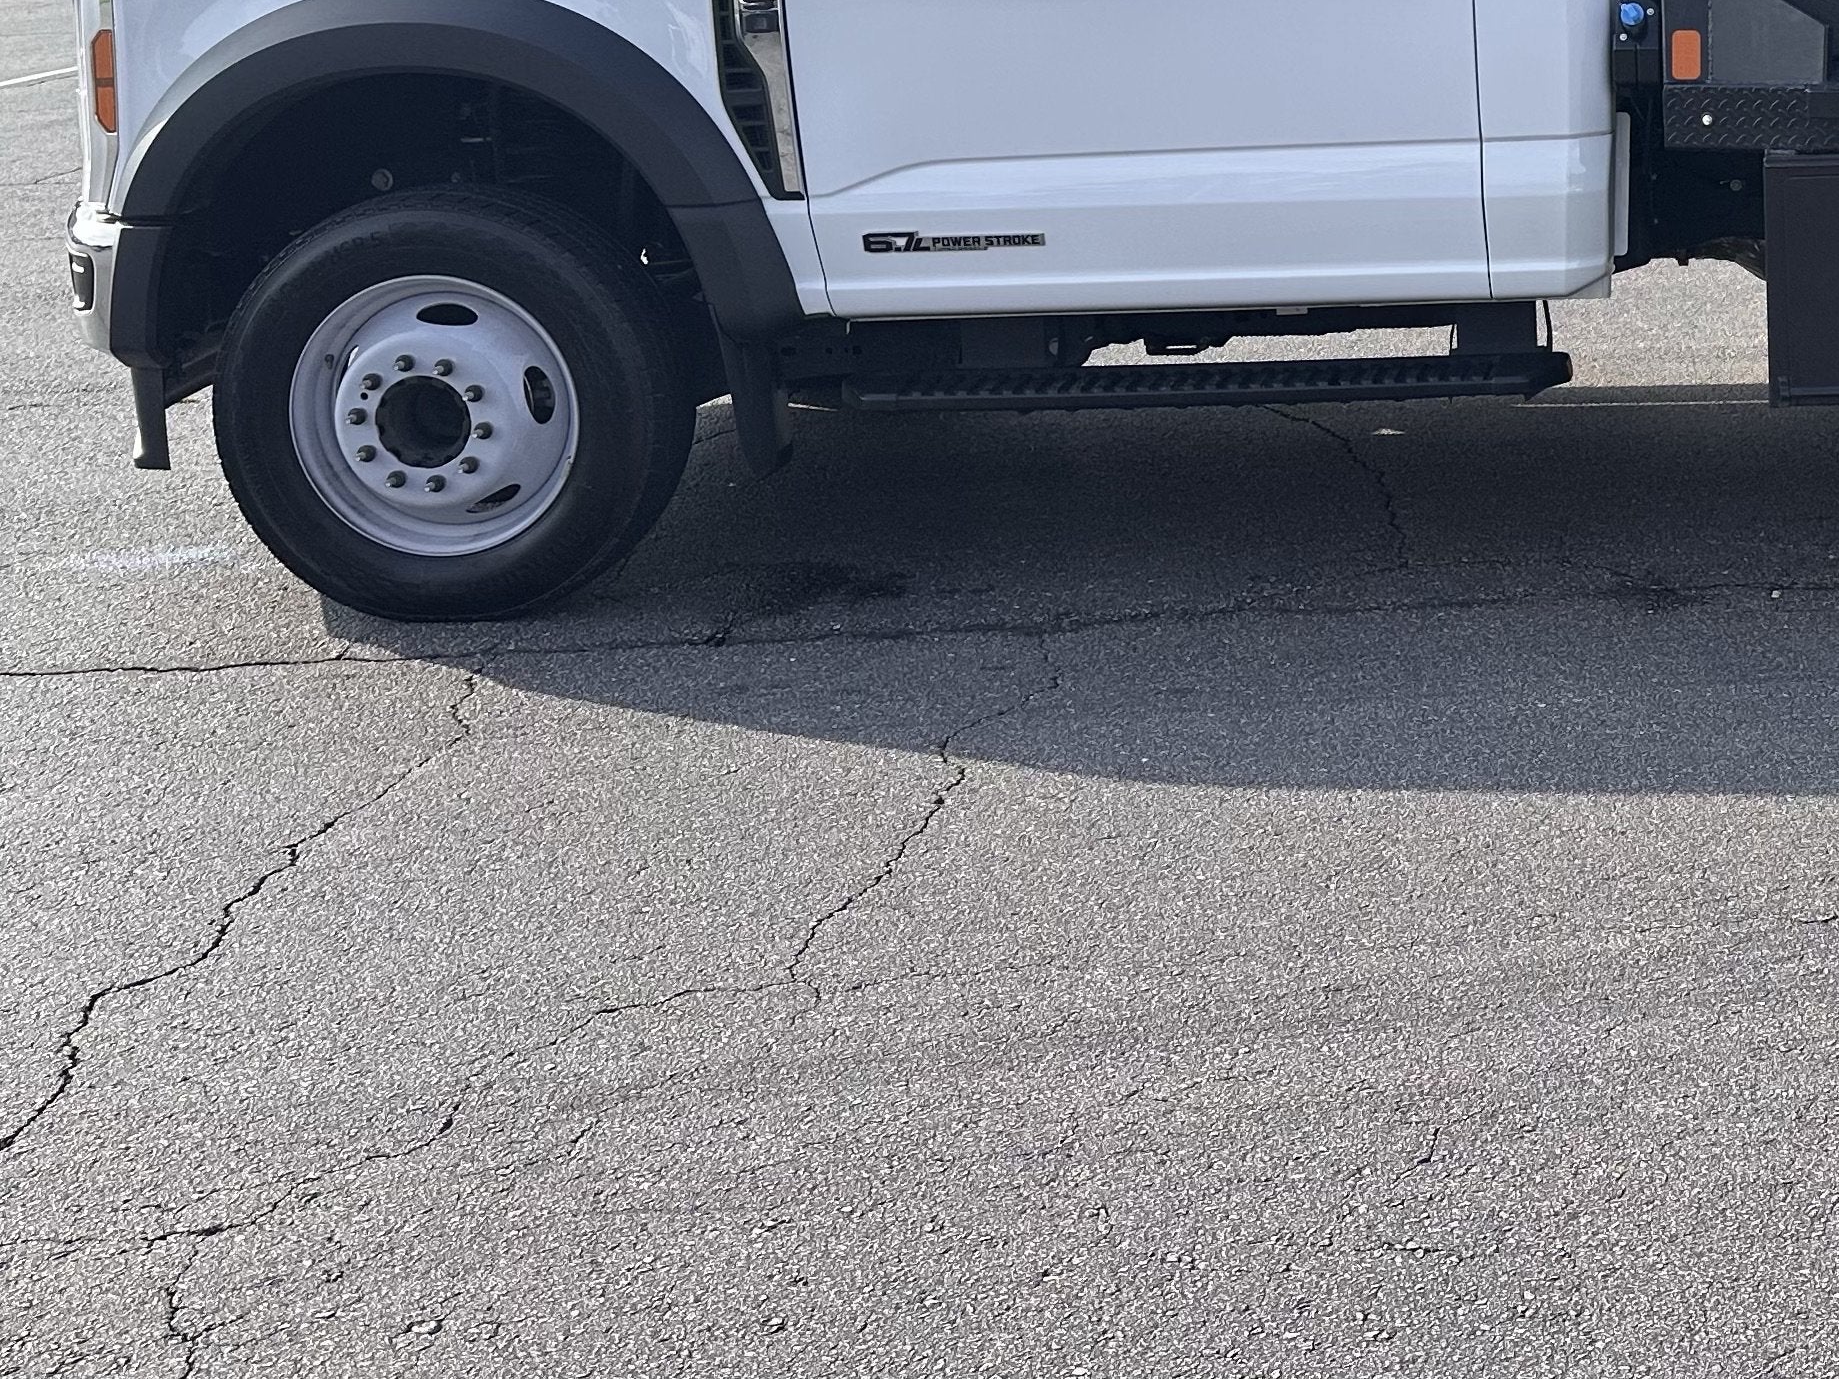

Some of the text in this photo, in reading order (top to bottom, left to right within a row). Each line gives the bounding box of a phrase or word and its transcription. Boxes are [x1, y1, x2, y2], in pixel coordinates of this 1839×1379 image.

[862, 231, 1041, 253] 6.7L POWER STROKE
